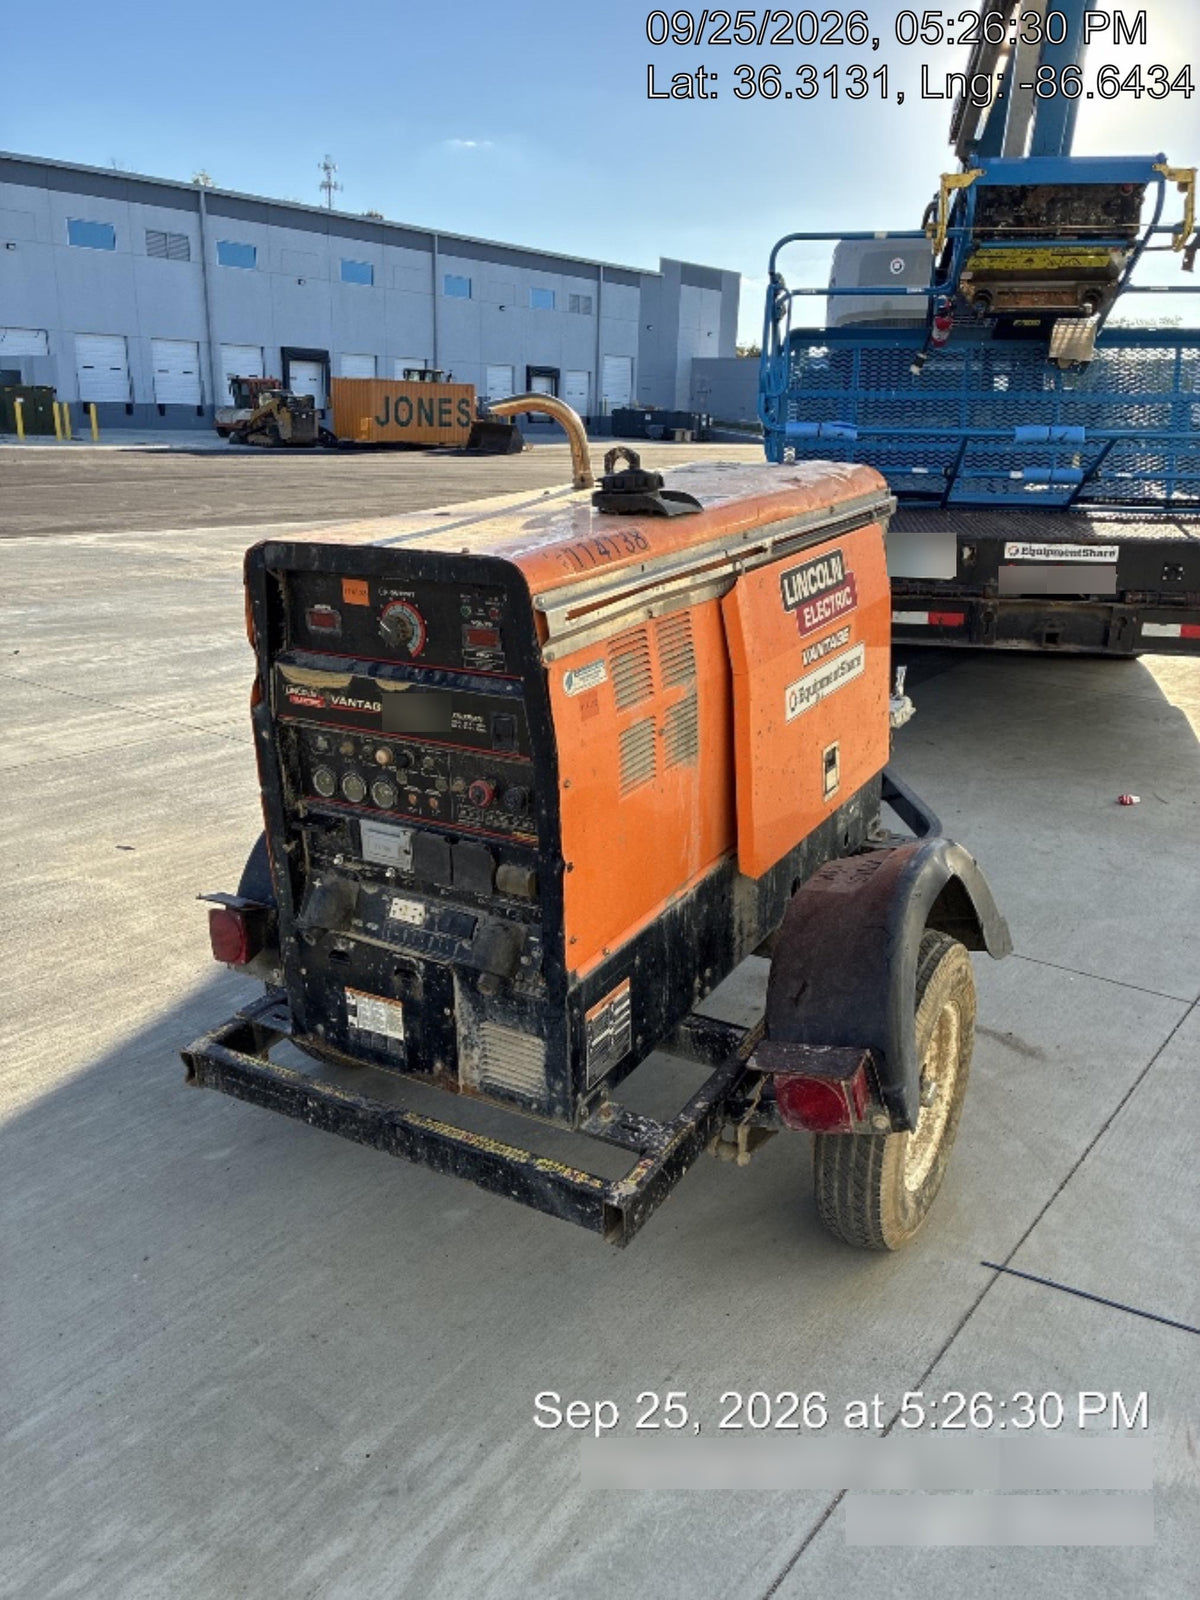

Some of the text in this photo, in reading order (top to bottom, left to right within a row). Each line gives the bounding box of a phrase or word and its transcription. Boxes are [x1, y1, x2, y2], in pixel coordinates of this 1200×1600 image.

[376, 396, 470, 427] JONES
[1020, 545, 1116, 558] EquipmentShare
[783, 555, 844, 606] LINCOLN
[803, 586, 853, 628] ELECTRIC
